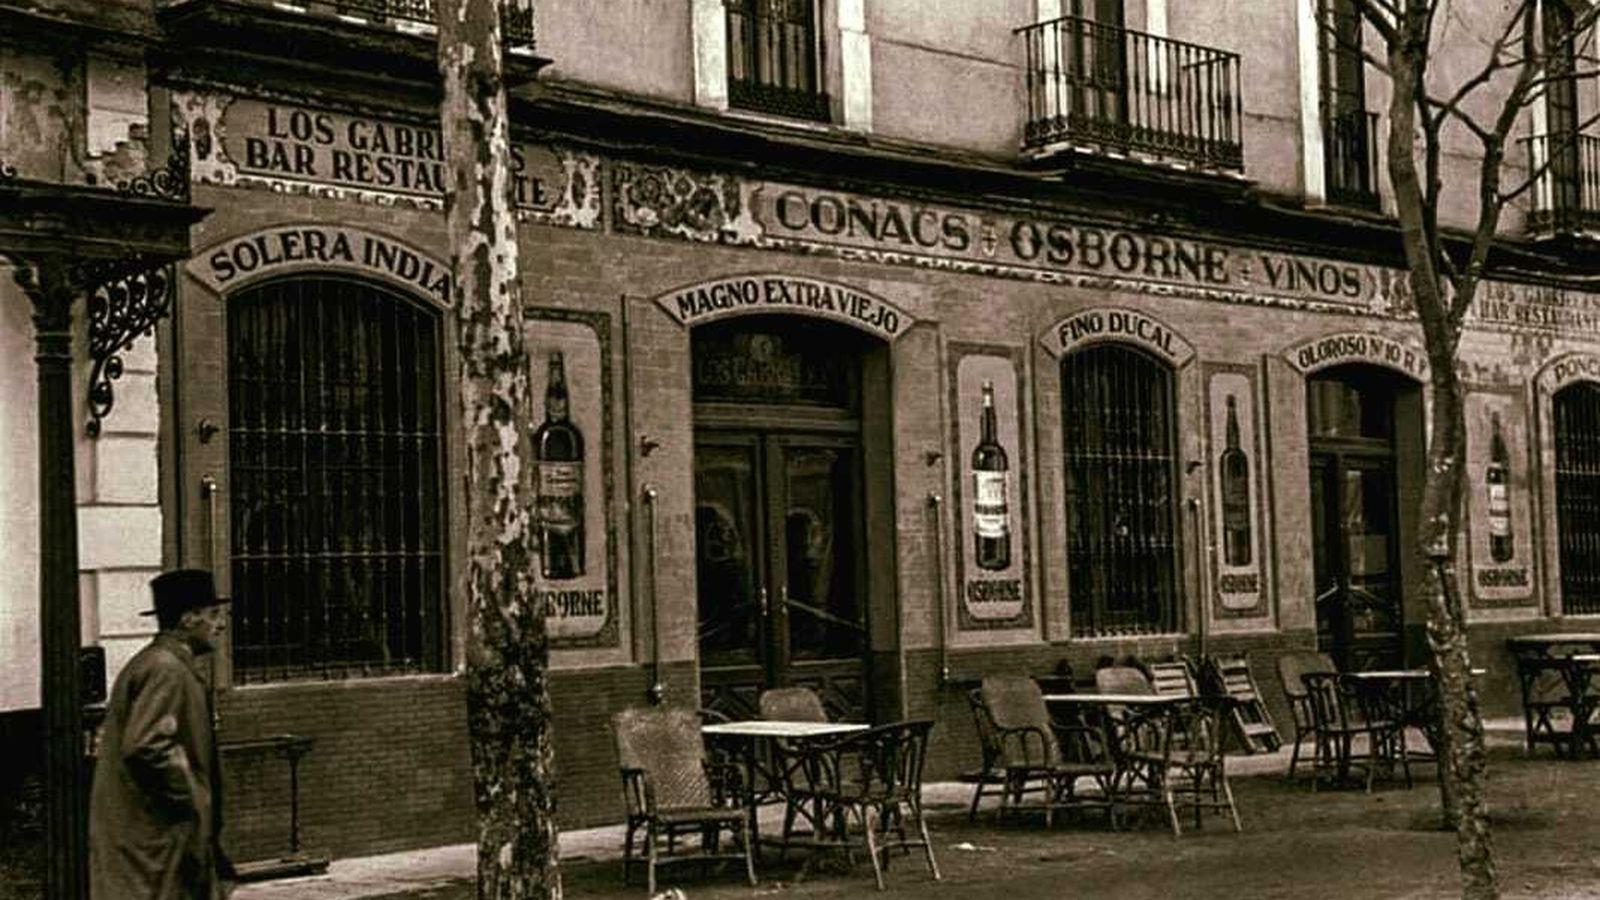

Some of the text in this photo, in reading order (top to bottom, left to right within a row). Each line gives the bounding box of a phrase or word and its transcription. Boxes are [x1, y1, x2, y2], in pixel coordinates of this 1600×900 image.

[245, 137, 547, 207] BAR RESTAUTE
[267, 107, 526, 173] LOS GABRIS
[210, 230, 455, 305] SOLERA INDIA
[774, 194, 1361, 298] CONACS OSBORNE VINOS
[675, 280, 759, 321] MAGNO
[1059, 311, 1176, 357] FINO DUCAL
